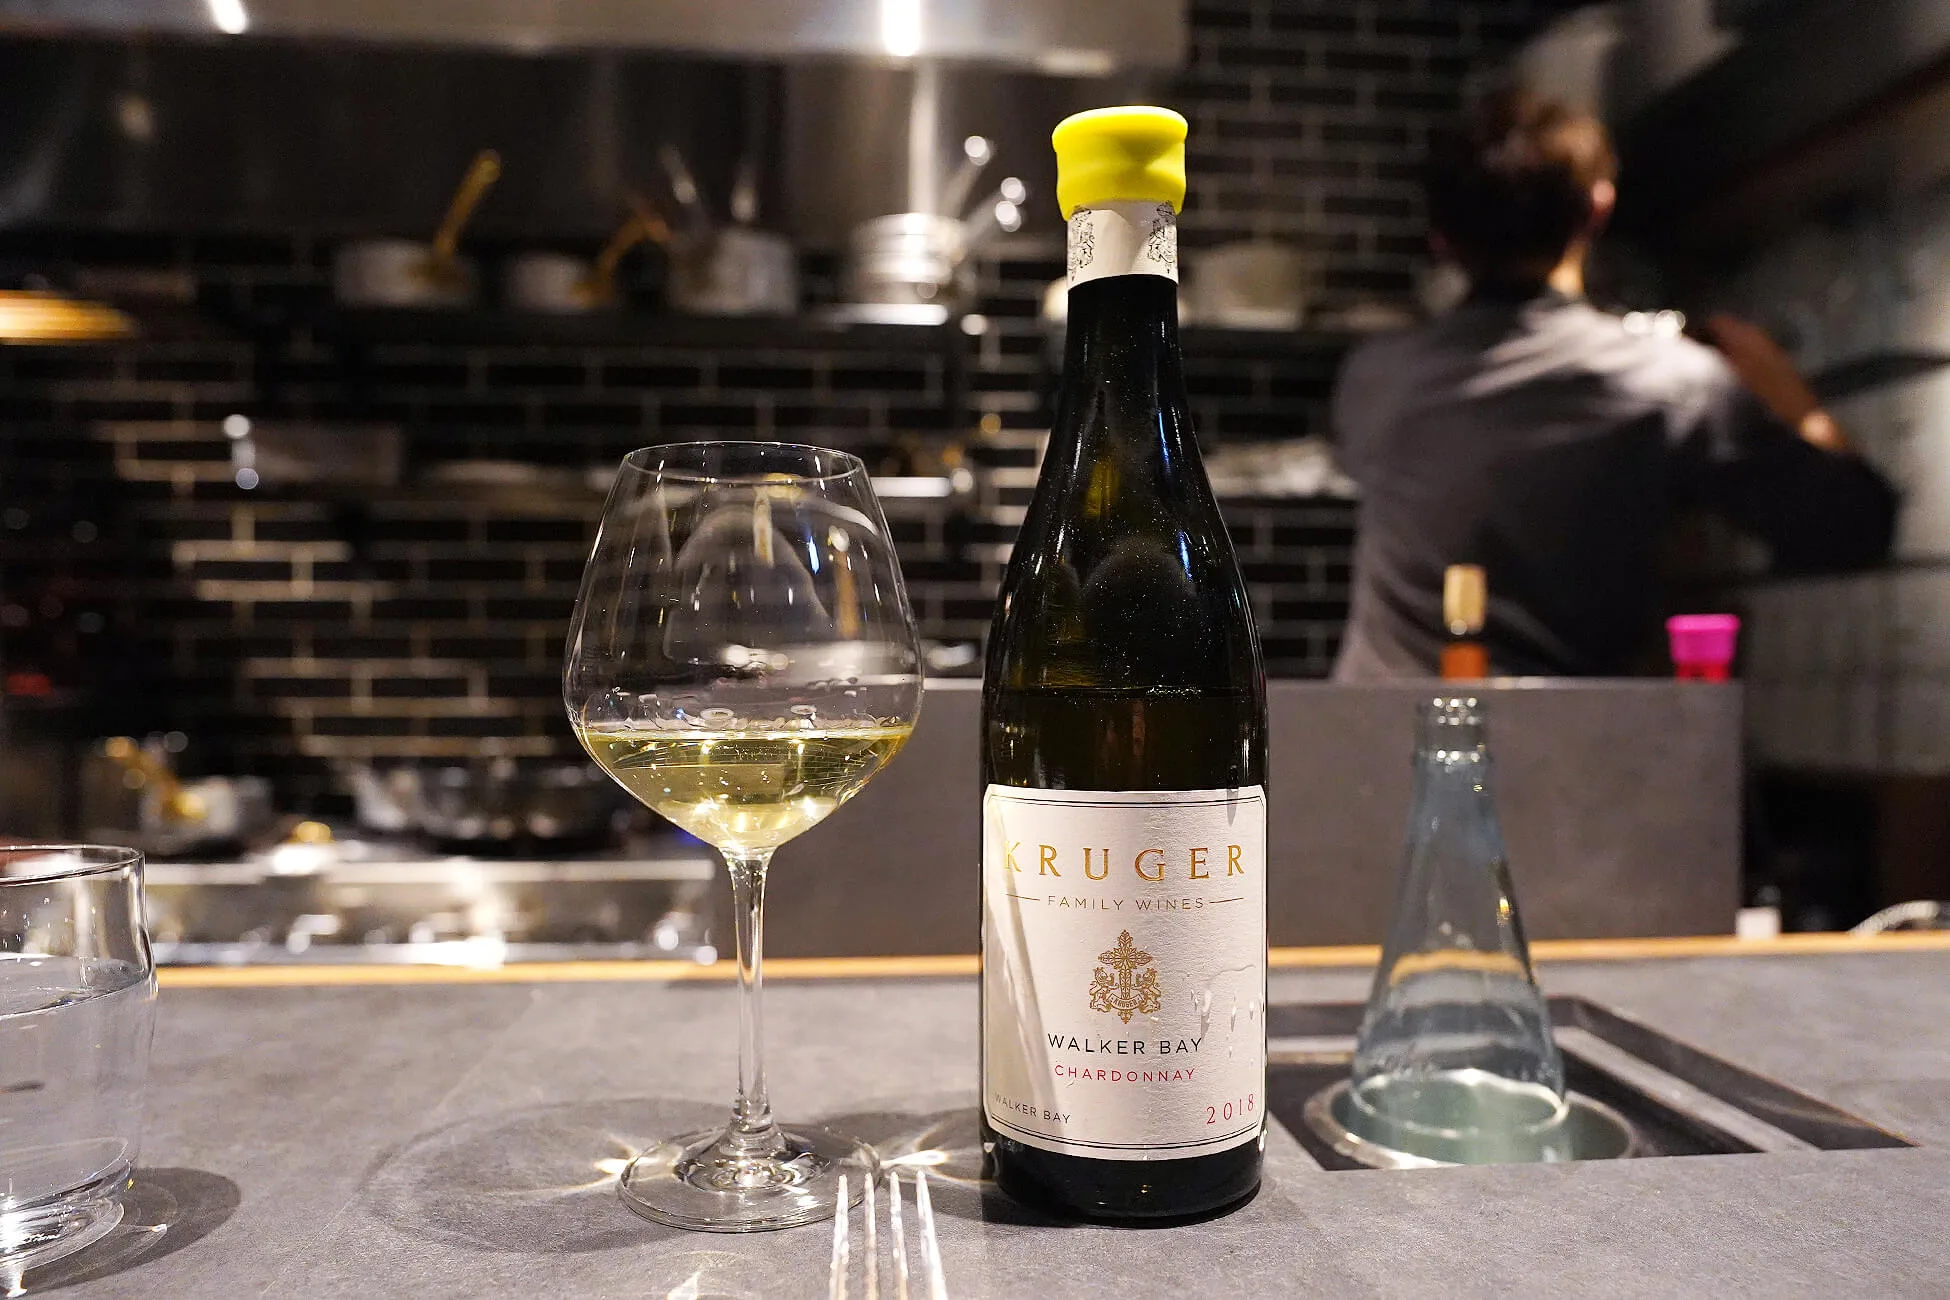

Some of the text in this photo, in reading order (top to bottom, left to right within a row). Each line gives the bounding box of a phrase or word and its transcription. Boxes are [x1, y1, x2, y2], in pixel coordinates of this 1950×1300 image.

[1003, 841, 1244, 882] KRUGER
[1048, 895, 1204, 911] FAMILY WINES
[1048, 1033, 1202, 1055] WALKER BAY
[1054, 1064, 1195, 1082] CHARDONNAY
[994, 1091, 1071, 1124] WALKER BAY
[1206, 1093, 1255, 1125] 2018
